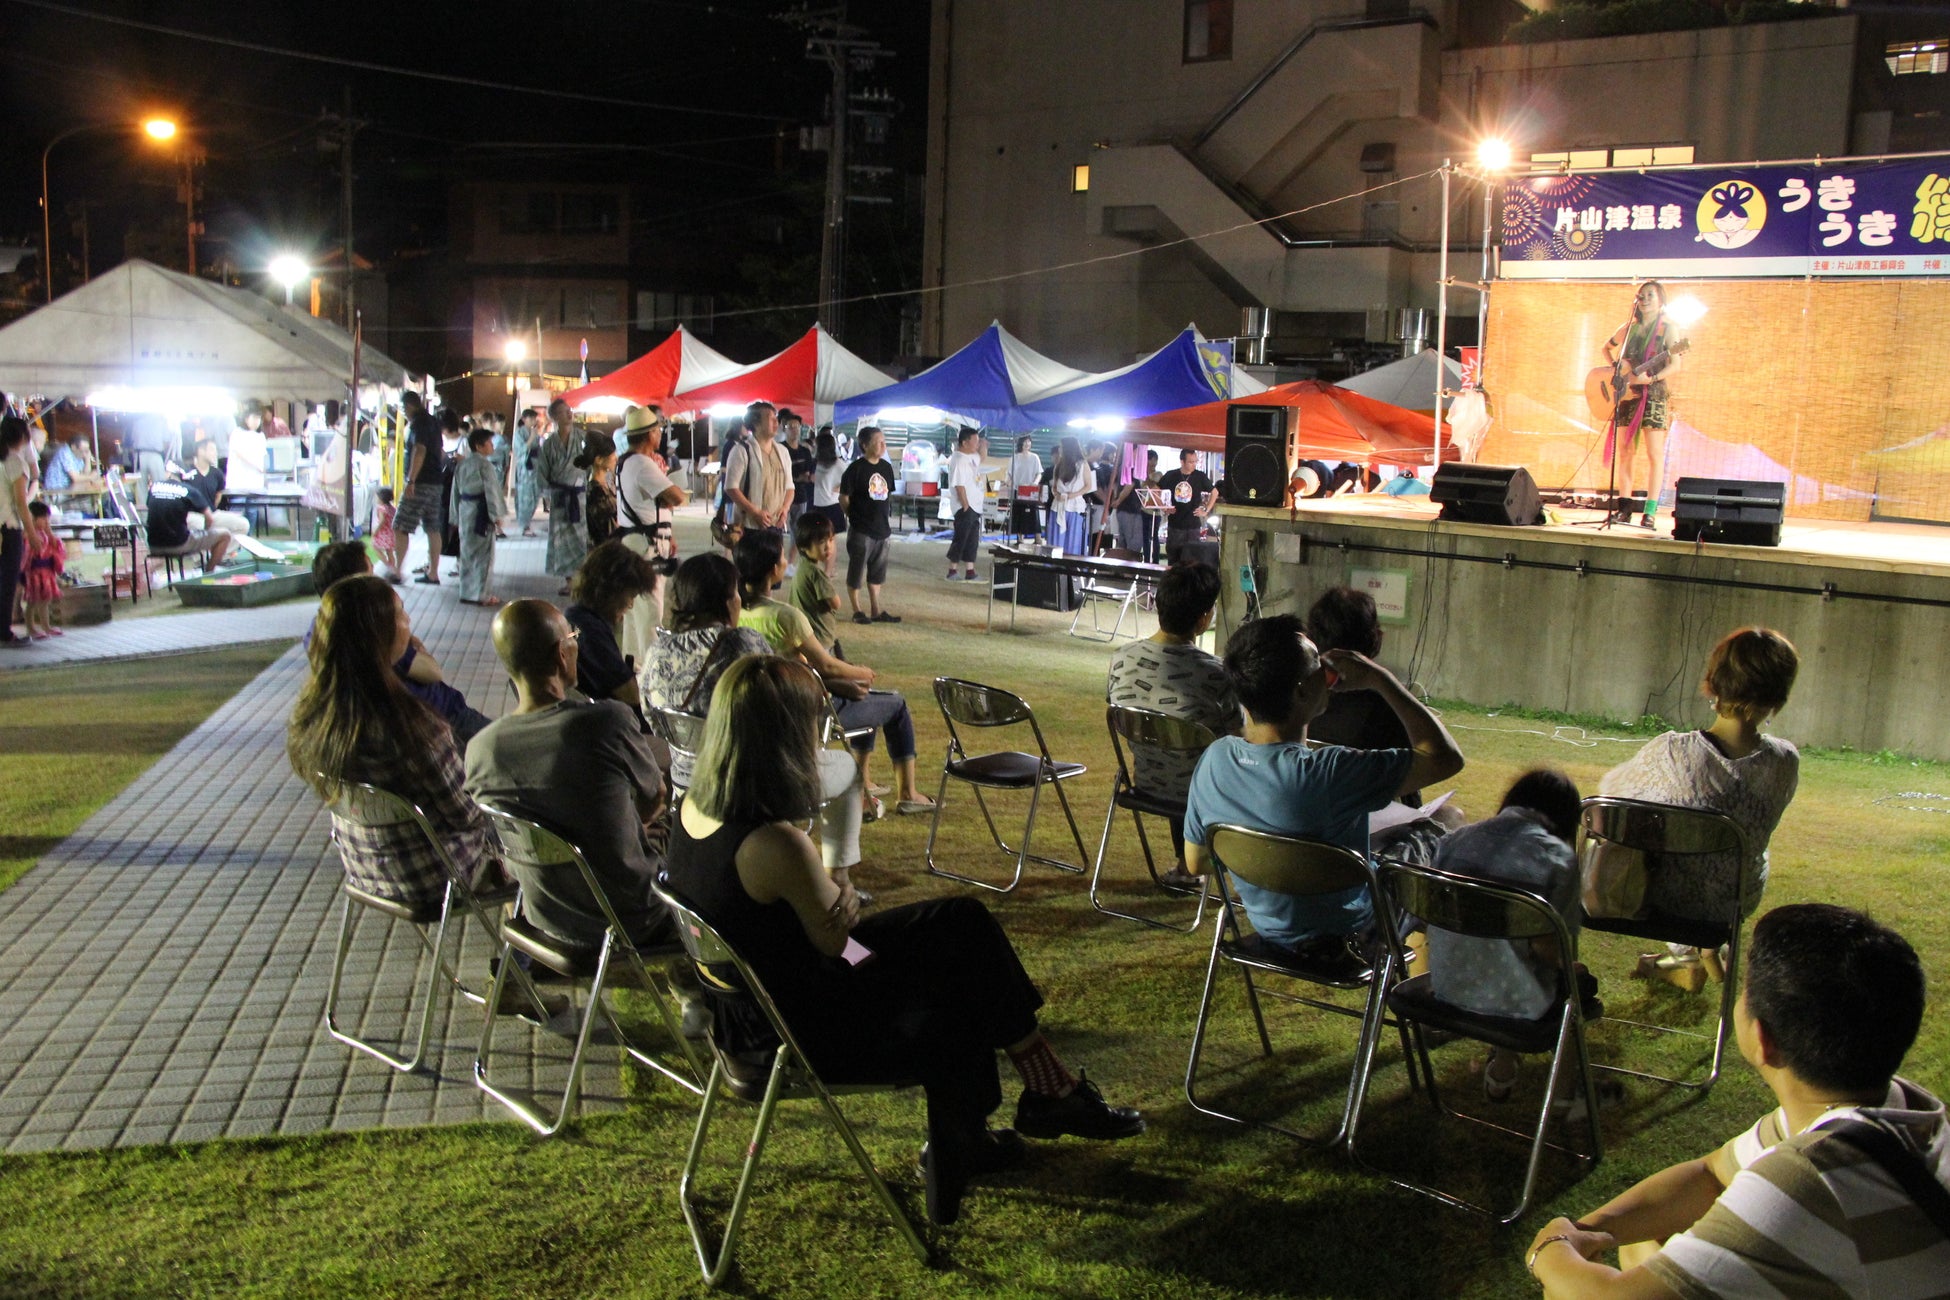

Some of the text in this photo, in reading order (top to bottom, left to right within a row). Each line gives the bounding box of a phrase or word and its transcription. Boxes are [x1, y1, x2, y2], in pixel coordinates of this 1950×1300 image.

[1778, 175, 1856, 213] うき
[1554, 203, 1683, 233] 片山津温泉
[1818, 209, 1898, 248] うき
